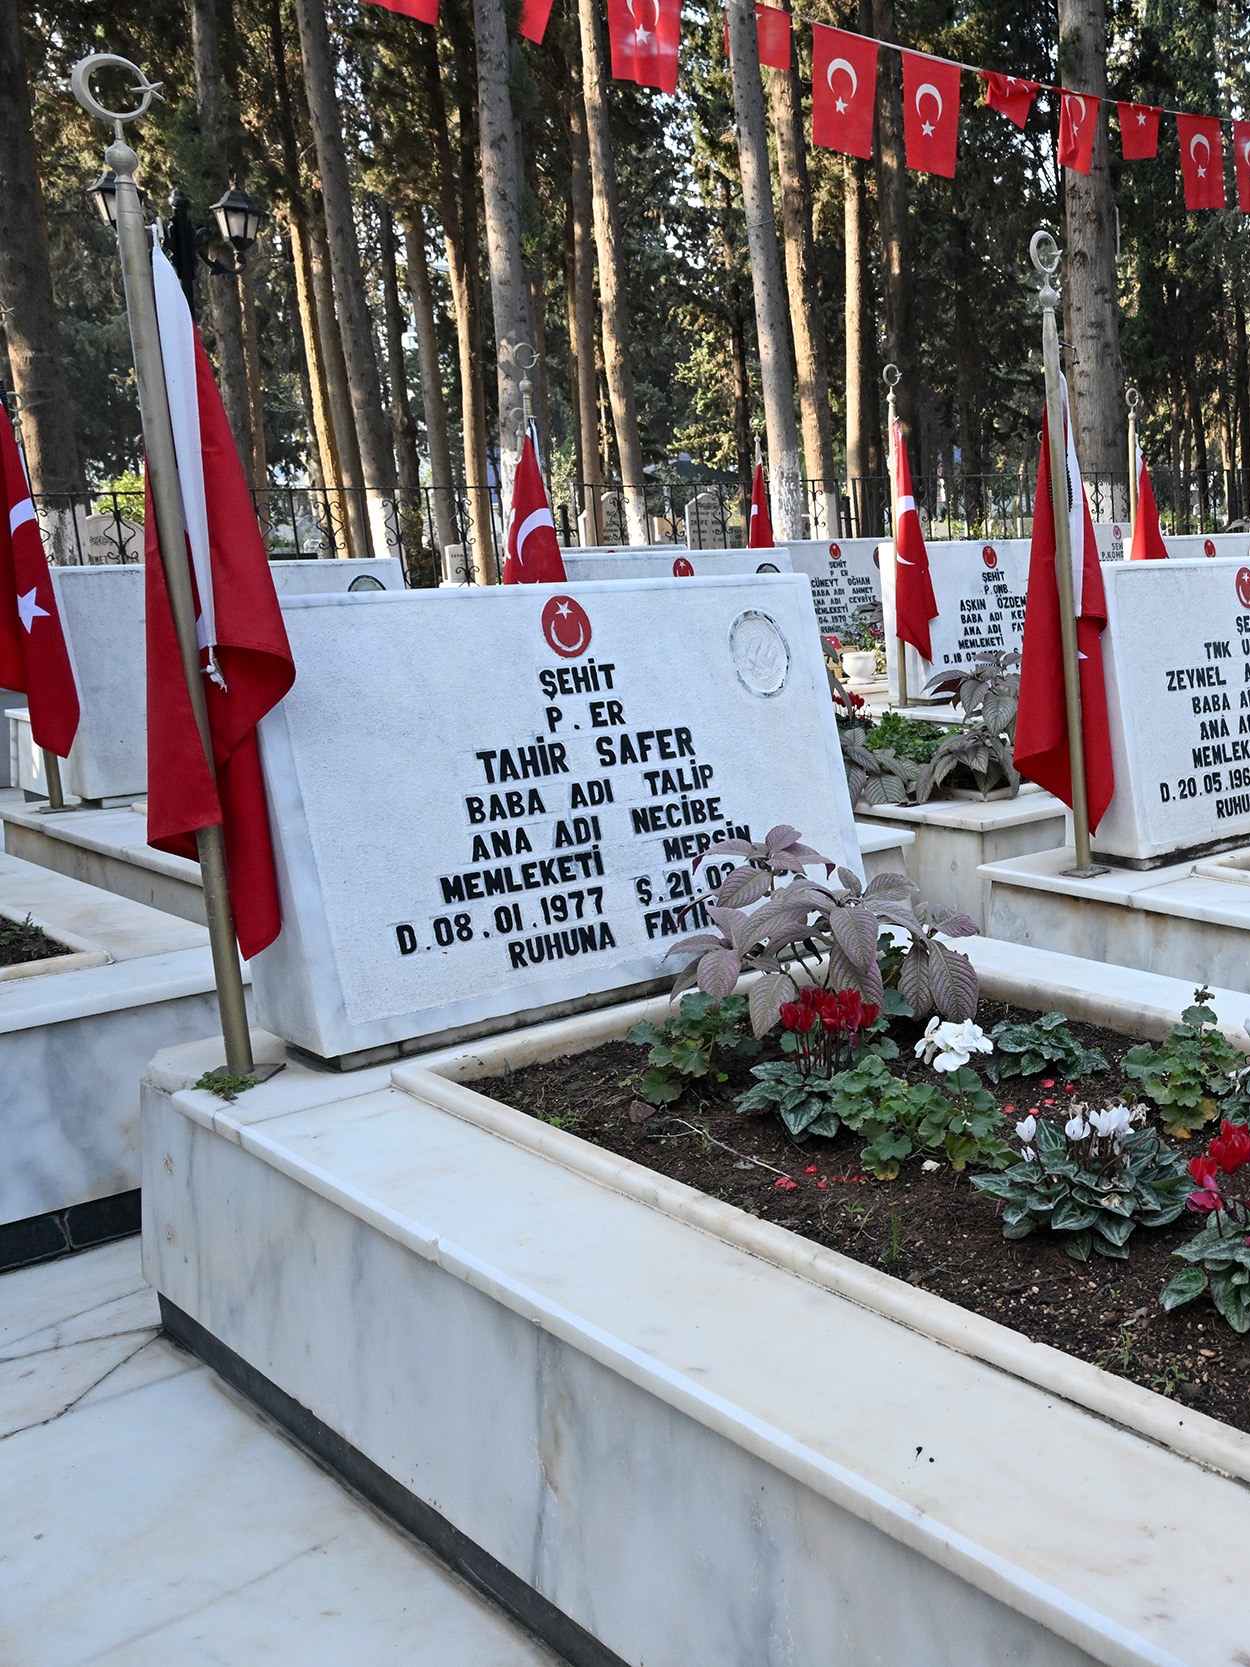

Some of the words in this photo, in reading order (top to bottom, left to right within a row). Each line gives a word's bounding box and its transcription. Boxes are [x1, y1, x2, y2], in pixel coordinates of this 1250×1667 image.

[811, 577, 839, 588] CÜNEYT
[982, 568, 1005, 583] ŞEHİT
[812, 589, 830, 597] BABA
[834, 588, 845, 596] ADI
[852, 587, 873, 595] AHMET
[830, 597, 841, 605] ADI
[960, 598, 986, 613] AŞKIN
[960, 613, 983, 624] BABA
[989, 612, 1003, 622] ADI
[964, 626, 982, 636] ANA
[988, 624, 1001, 634] ADI
[958, 633, 1004, 650] MEMLEKETİ
[1204, 641, 1232, 660] TNK
[539, 657, 616, 701] ŞEHİT
[1165, 666, 1227, 692] ZEYNEL
[590, 699, 626, 728] ER
[1192, 691, 1231, 714] BABA
[1200, 719, 1230, 741] ANA
[476, 735, 569, 783] TAHİR
[596, 726, 696, 767] SAFER
[465, 787, 546, 825] BABA
[571, 778, 614, 810] ADI
[645, 758, 714, 797] TALİP
[472, 827, 532, 862] ANA
[555, 815, 601, 850] ADI
[631, 793, 724, 835] NECİBE
[440, 843, 605, 904] MEMLEKETİ
[508, 920, 617, 969] RUHUNA
[644, 896, 717, 940] FATİH
